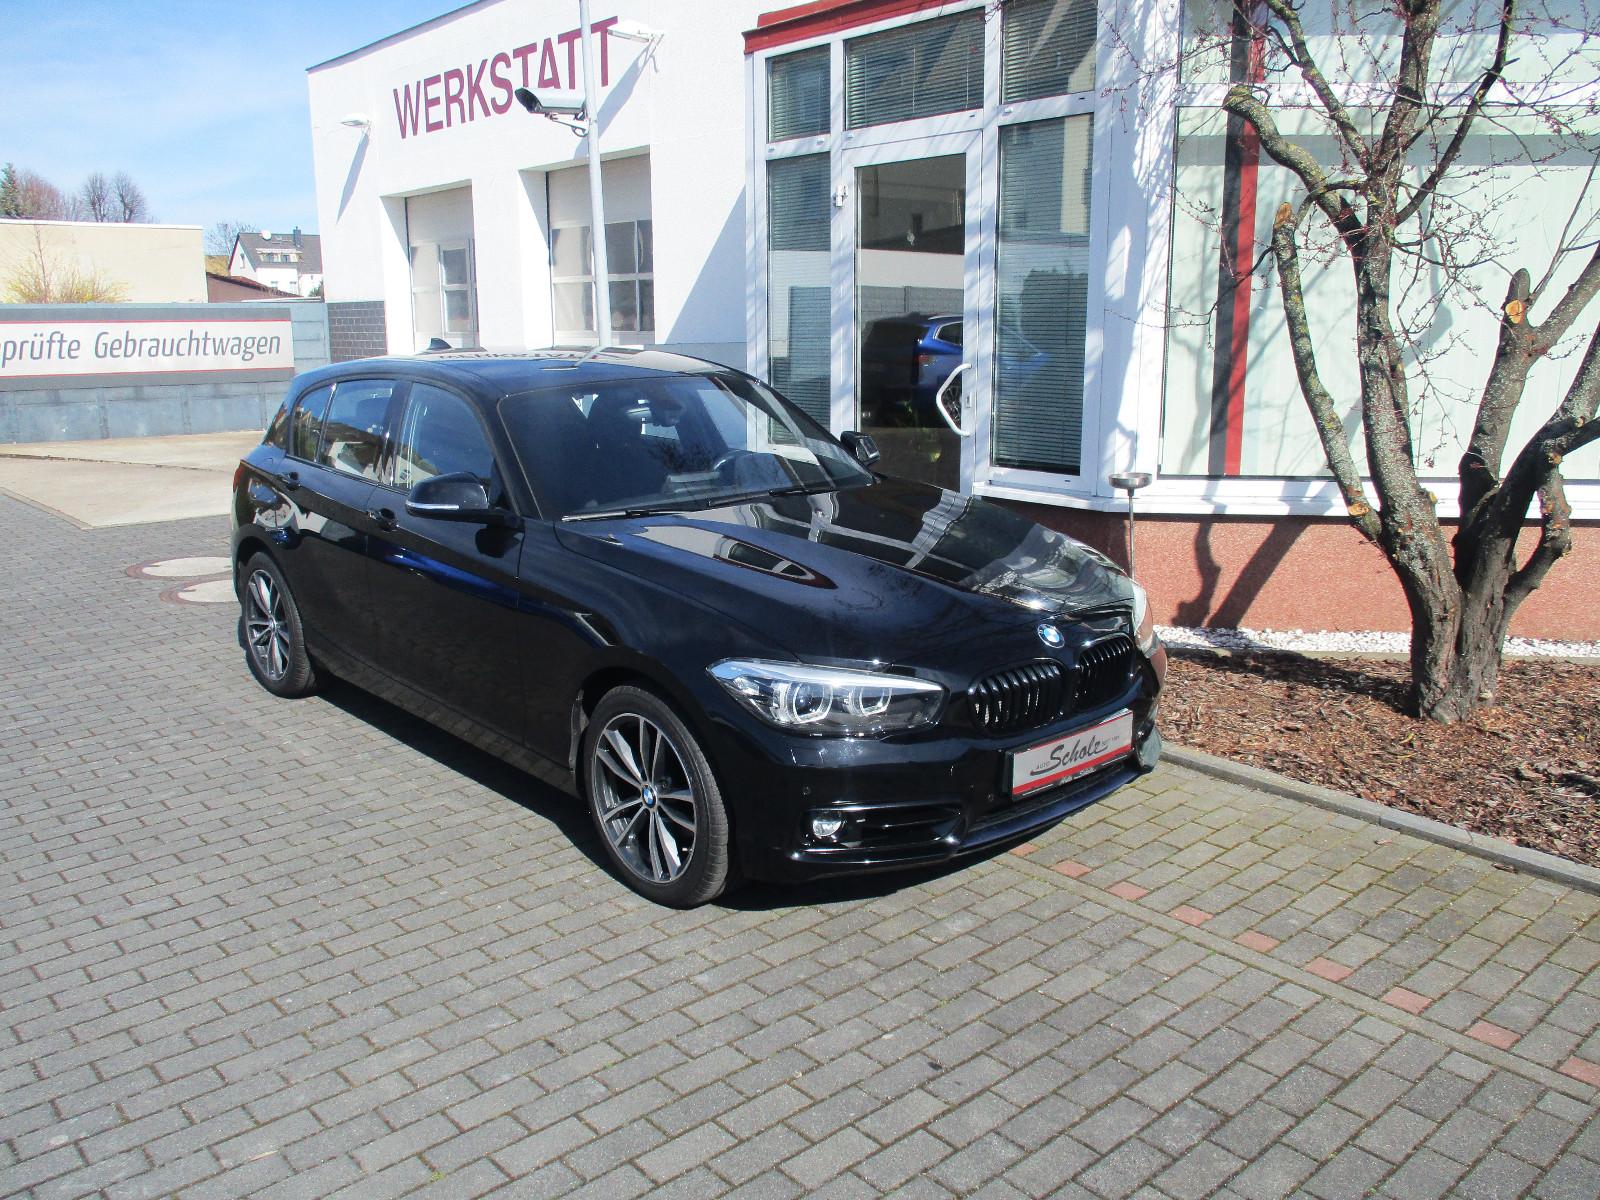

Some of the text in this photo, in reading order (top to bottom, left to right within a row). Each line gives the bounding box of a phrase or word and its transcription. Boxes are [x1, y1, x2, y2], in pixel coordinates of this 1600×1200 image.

[393, 16, 618, 139] WERKSTATT
[0, 329, 281, 368] prüfte Gebrauchtwagen
